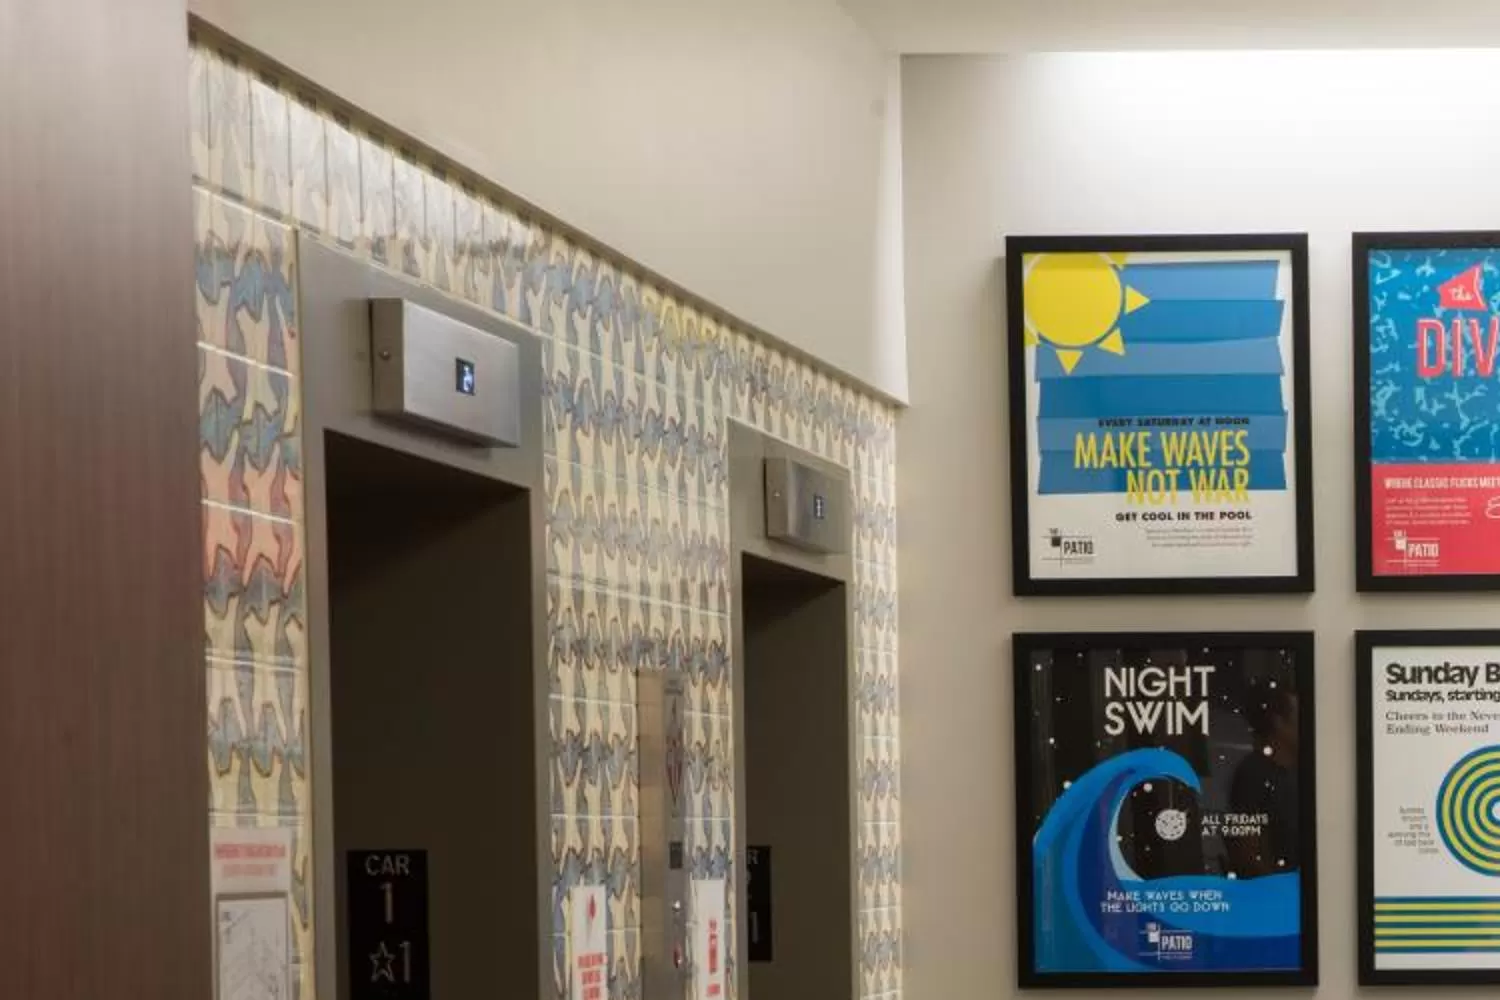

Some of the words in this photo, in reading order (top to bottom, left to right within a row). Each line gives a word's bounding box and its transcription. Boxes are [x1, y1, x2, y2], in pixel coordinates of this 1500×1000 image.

[1449, 285, 1474, 302] the
[1137, 418, 1194, 427] SATURDAY
[1199, 418, 1212, 426] AT
[1074, 431, 1152, 468] MAKE
[1160, 430, 1250, 467] WAVES
[1126, 469, 1181, 506] NOT
[1190, 468, 1250, 505] WAR
[1115, 512, 1137, 521] GET
[1142, 512, 1174, 521] COOL
[1177, 512, 1191, 521] IN
[1195, 512, 1215, 520] THE
[1220, 511, 1252, 520] POOL
[1063, 541, 1094, 555] PATIO
[1407, 543, 1439, 557] PATIO
[1103, 665, 1216, 698] NIGHT
[1386, 662, 1480, 688] Sunday
[1385, 689, 1445, 704] Sundays,
[1103, 701, 1210, 736] SWIM
[1385, 711, 1428, 721] Cheers
[1432, 712, 1445, 721] to
[1447, 710, 1466, 721] the
[1386, 724, 1431, 735] Ending
[1435, 723, 1489, 734] Weekend
[1201, 814, 1220, 825] ALL
[1224, 813, 1268, 825] FRIDAYS
[1201, 826, 1218, 836] AT
[365, 855, 410, 877] CAR
[1107, 890, 1141, 901] MAKE
[1145, 890, 1184, 901] WAVES
[1189, 889, 1223, 901] WHEN
[380, 882, 393, 924] 1
[1100, 902, 1123, 913] THE
[1126, 902, 1165, 913] LIGHTS
[1170, 902, 1190, 913] GO
[1194, 902, 1230, 912] DOWN
[1162, 935, 1193, 950] PATIO
